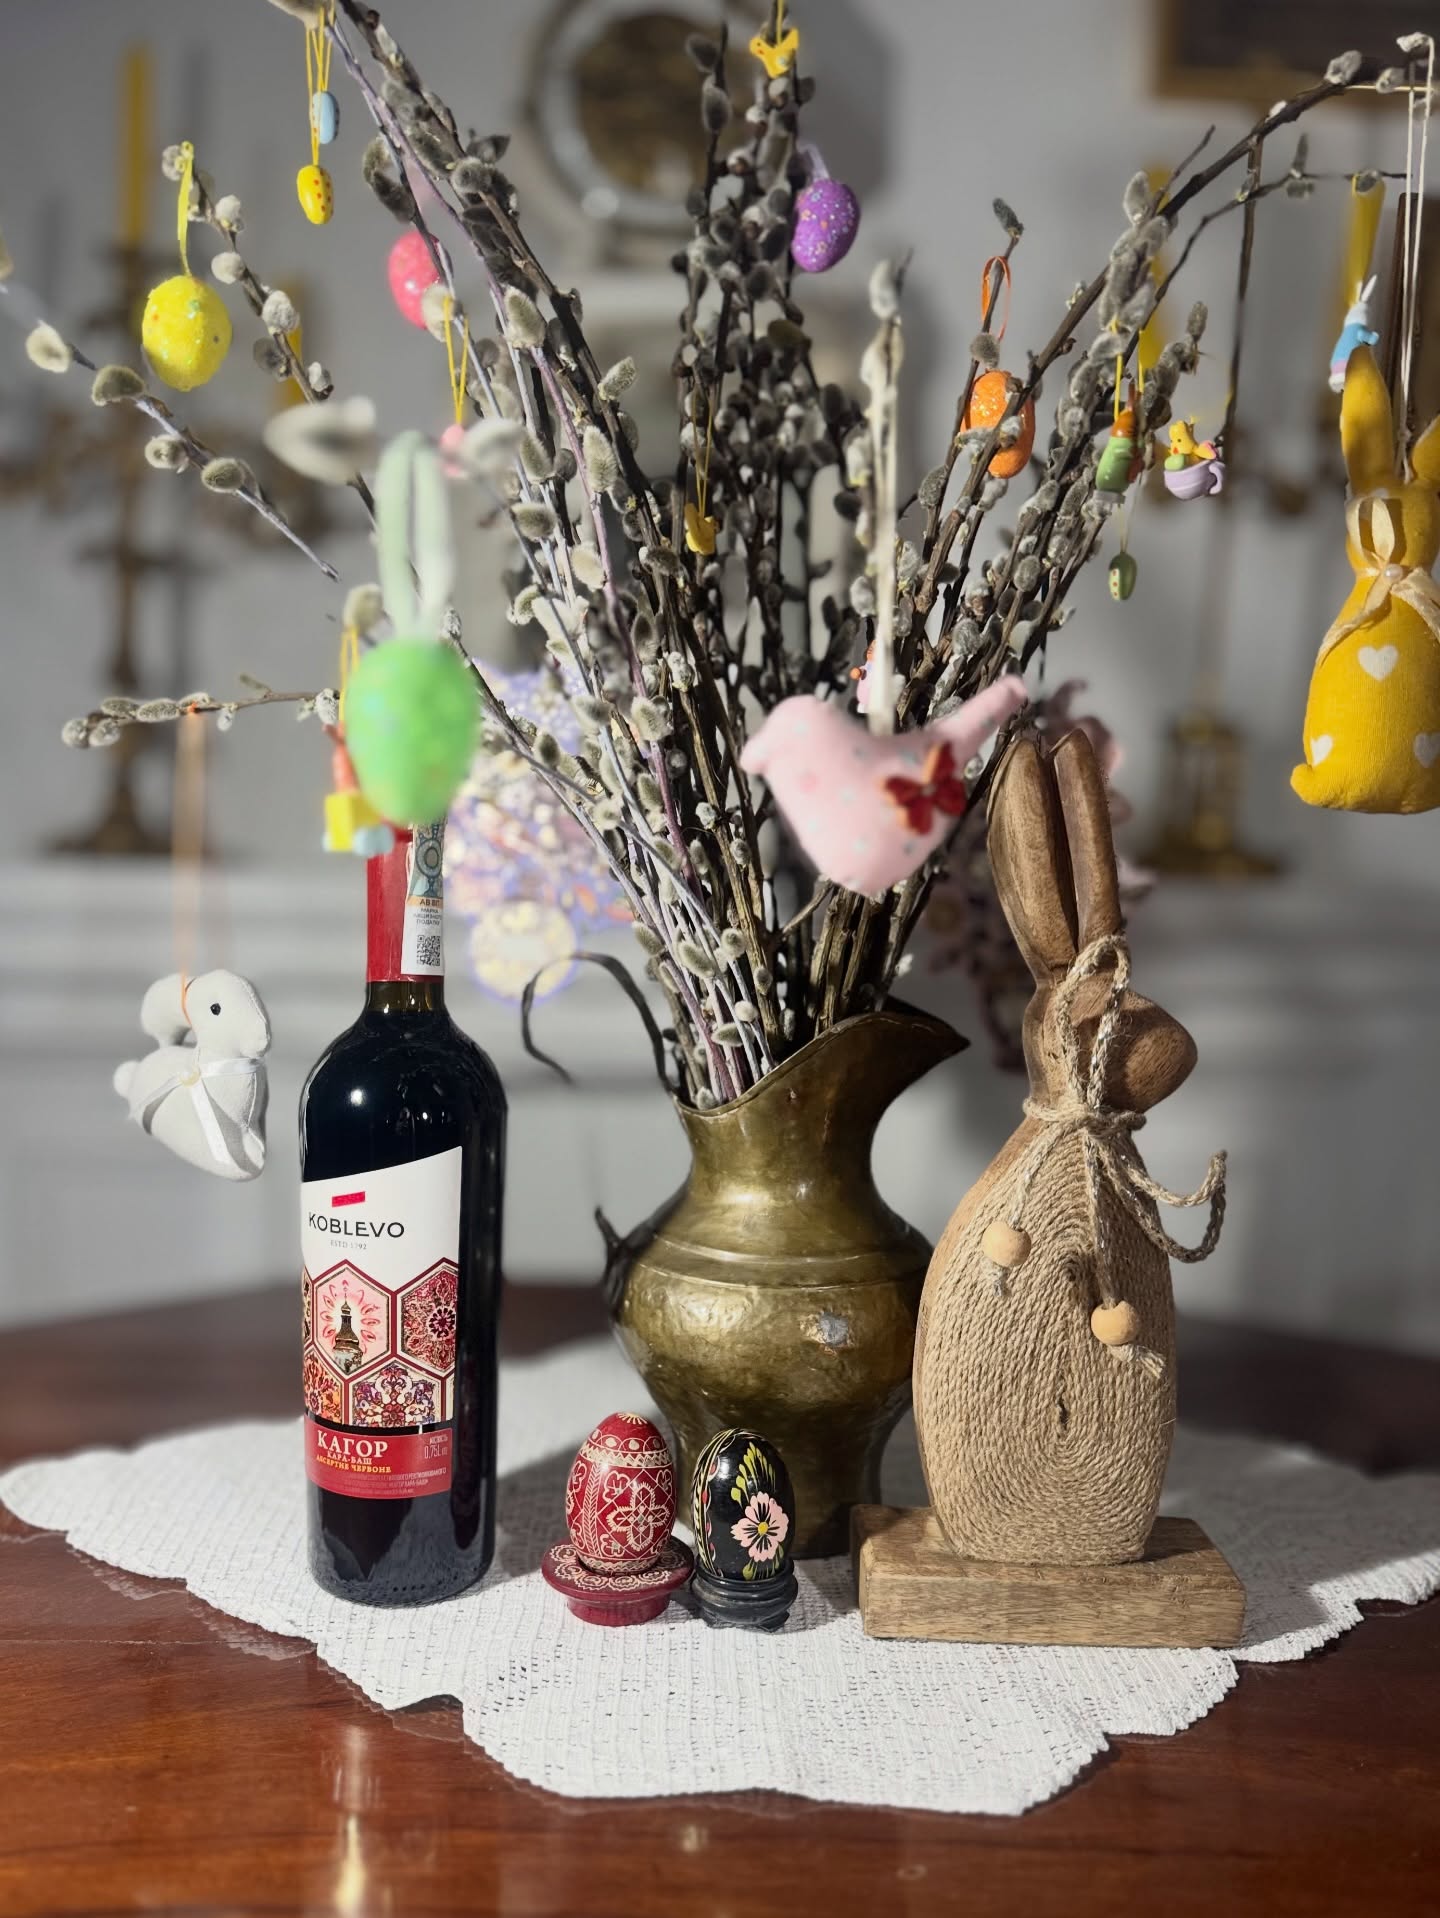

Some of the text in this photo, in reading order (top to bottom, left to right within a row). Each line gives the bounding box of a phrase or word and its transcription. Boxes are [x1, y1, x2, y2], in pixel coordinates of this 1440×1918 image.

[308, 1211, 405, 1238] KOBLEVO
[317, 1429, 388, 1458] КАГОР
[327, 1450, 373, 1465] КАРА-БАШ
[351, 1464, 392, 1474] ЧЕРВОНЕ
